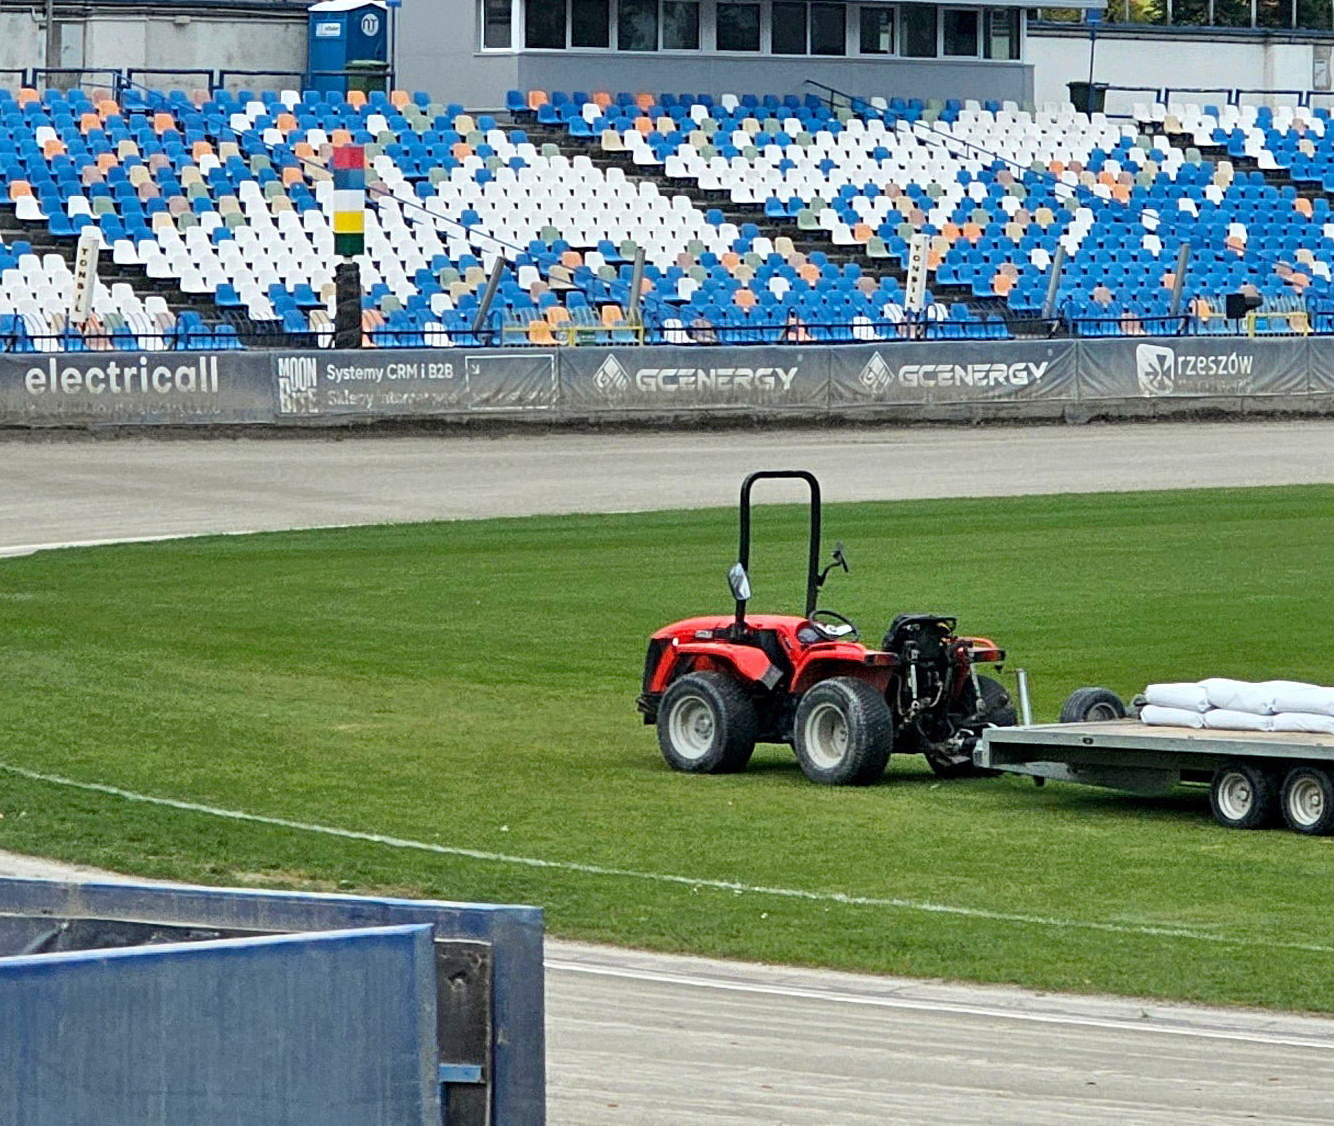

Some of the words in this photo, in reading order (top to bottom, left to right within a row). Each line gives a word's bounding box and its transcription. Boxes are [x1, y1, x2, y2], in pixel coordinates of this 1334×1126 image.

[75, 247, 89, 313] TONSIL
[909, 244, 921, 304] TONSIL
[24, 356, 219, 395] electricall
[278, 357, 317, 391] MOON
[327, 364, 384, 383] Systemy
[386, 363, 418, 380] CRM
[420, 362, 425, 379] i
[428, 363, 454, 379] B2B
[898, 361, 1049, 388] GCENERGY
[1177, 351, 1254, 376] rzeszów
[636, 367, 799, 392] GCENERGY
